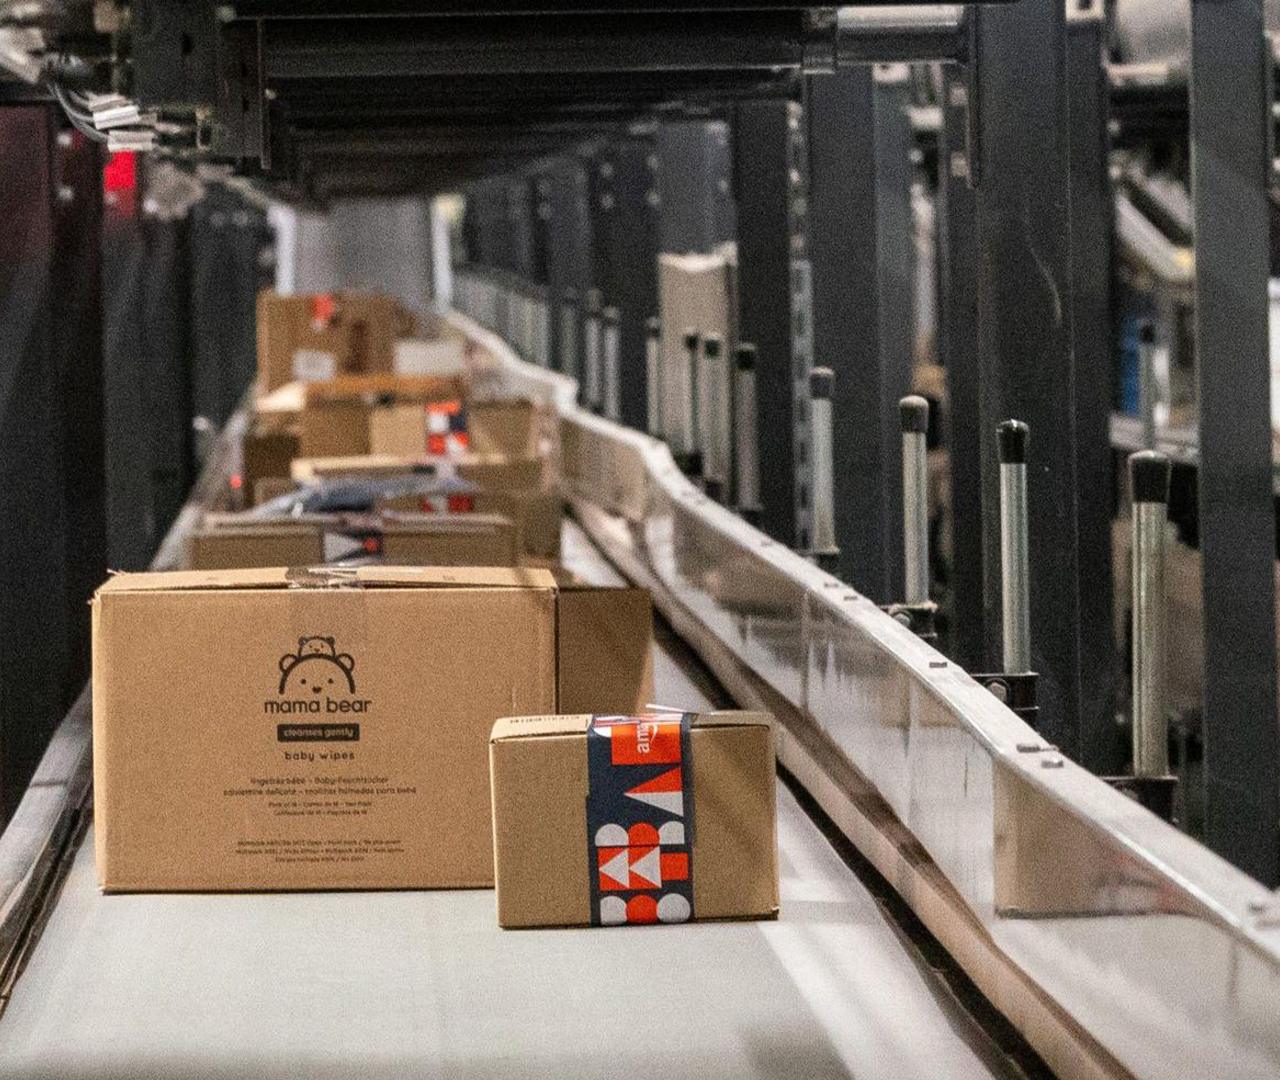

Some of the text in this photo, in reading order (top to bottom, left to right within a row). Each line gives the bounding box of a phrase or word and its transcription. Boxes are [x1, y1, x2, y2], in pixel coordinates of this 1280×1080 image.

[263, 697, 373, 714] mama bear
[324, 727, 354, 739] gently
[284, 750, 355, 762] baby wipes
